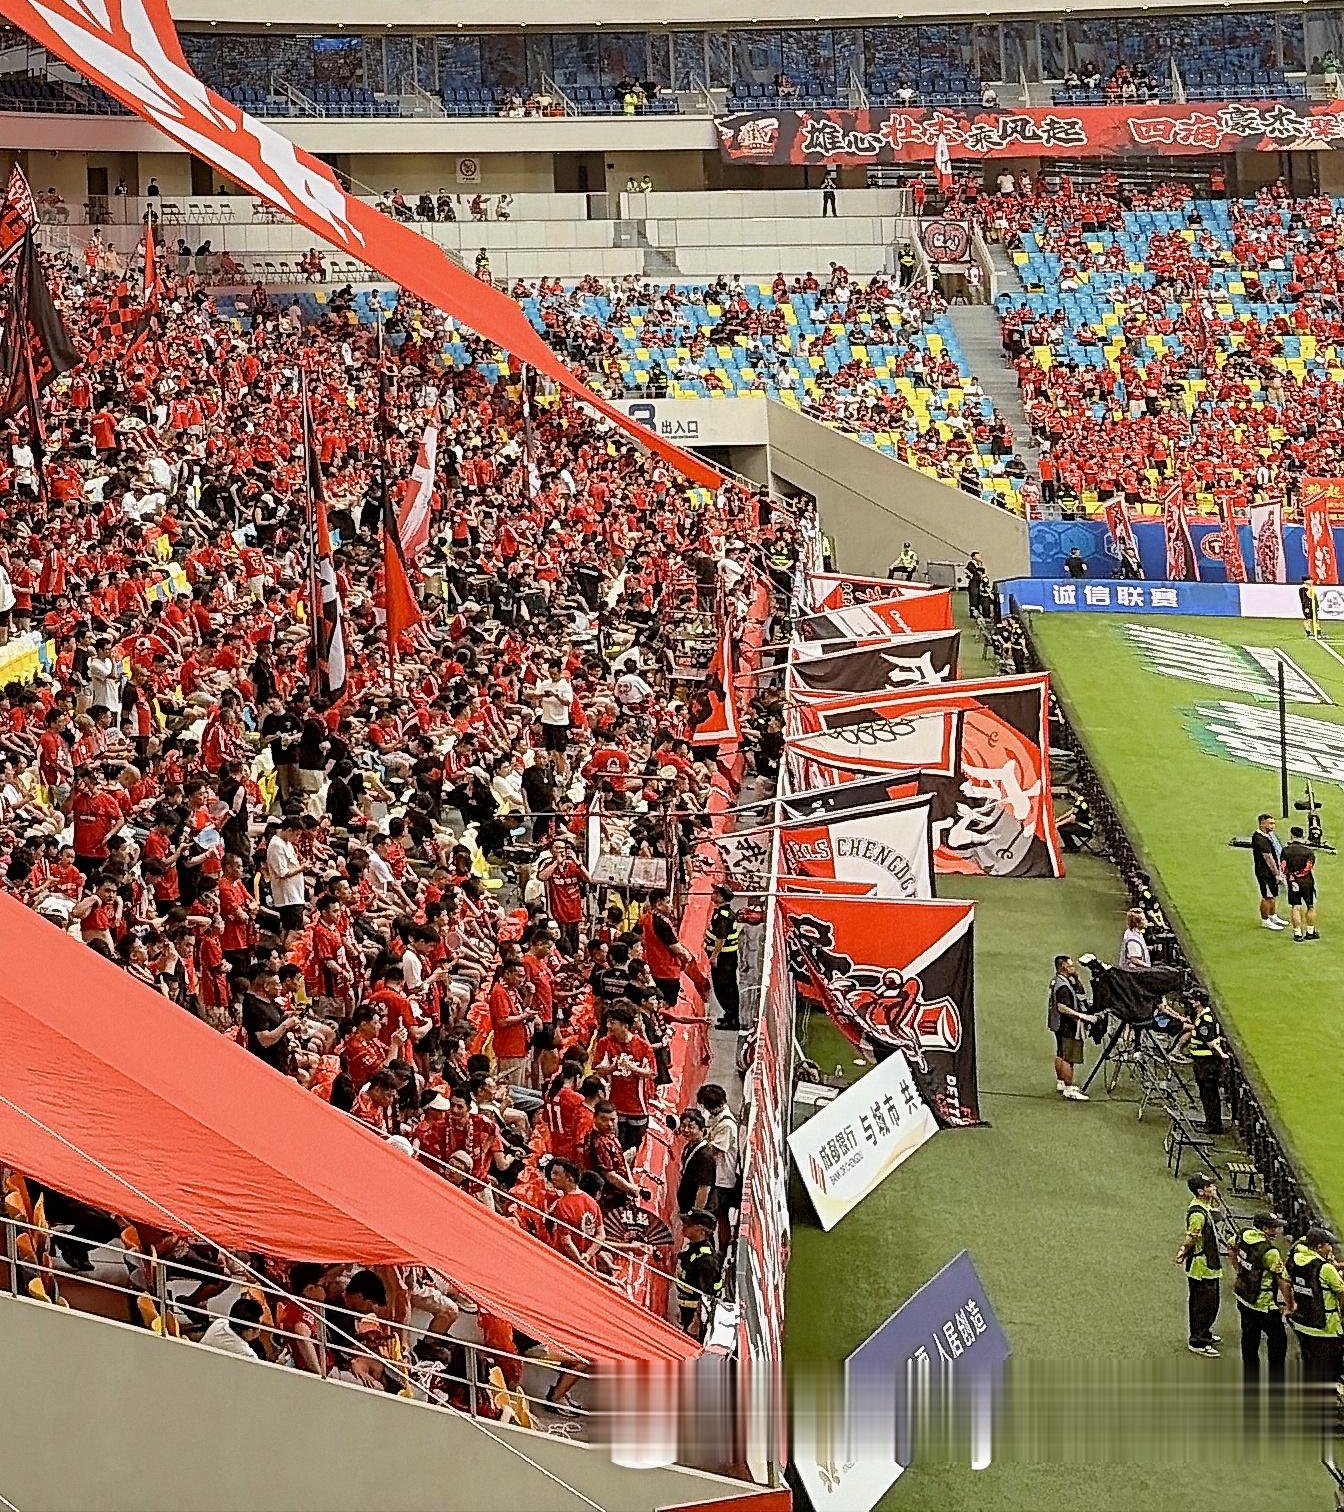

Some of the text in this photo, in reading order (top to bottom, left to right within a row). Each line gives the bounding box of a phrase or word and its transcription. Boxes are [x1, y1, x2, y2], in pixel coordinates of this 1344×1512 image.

[662, 420, 698, 435] 出入口
[1053, 584, 1179, 608] 诚信联赛
